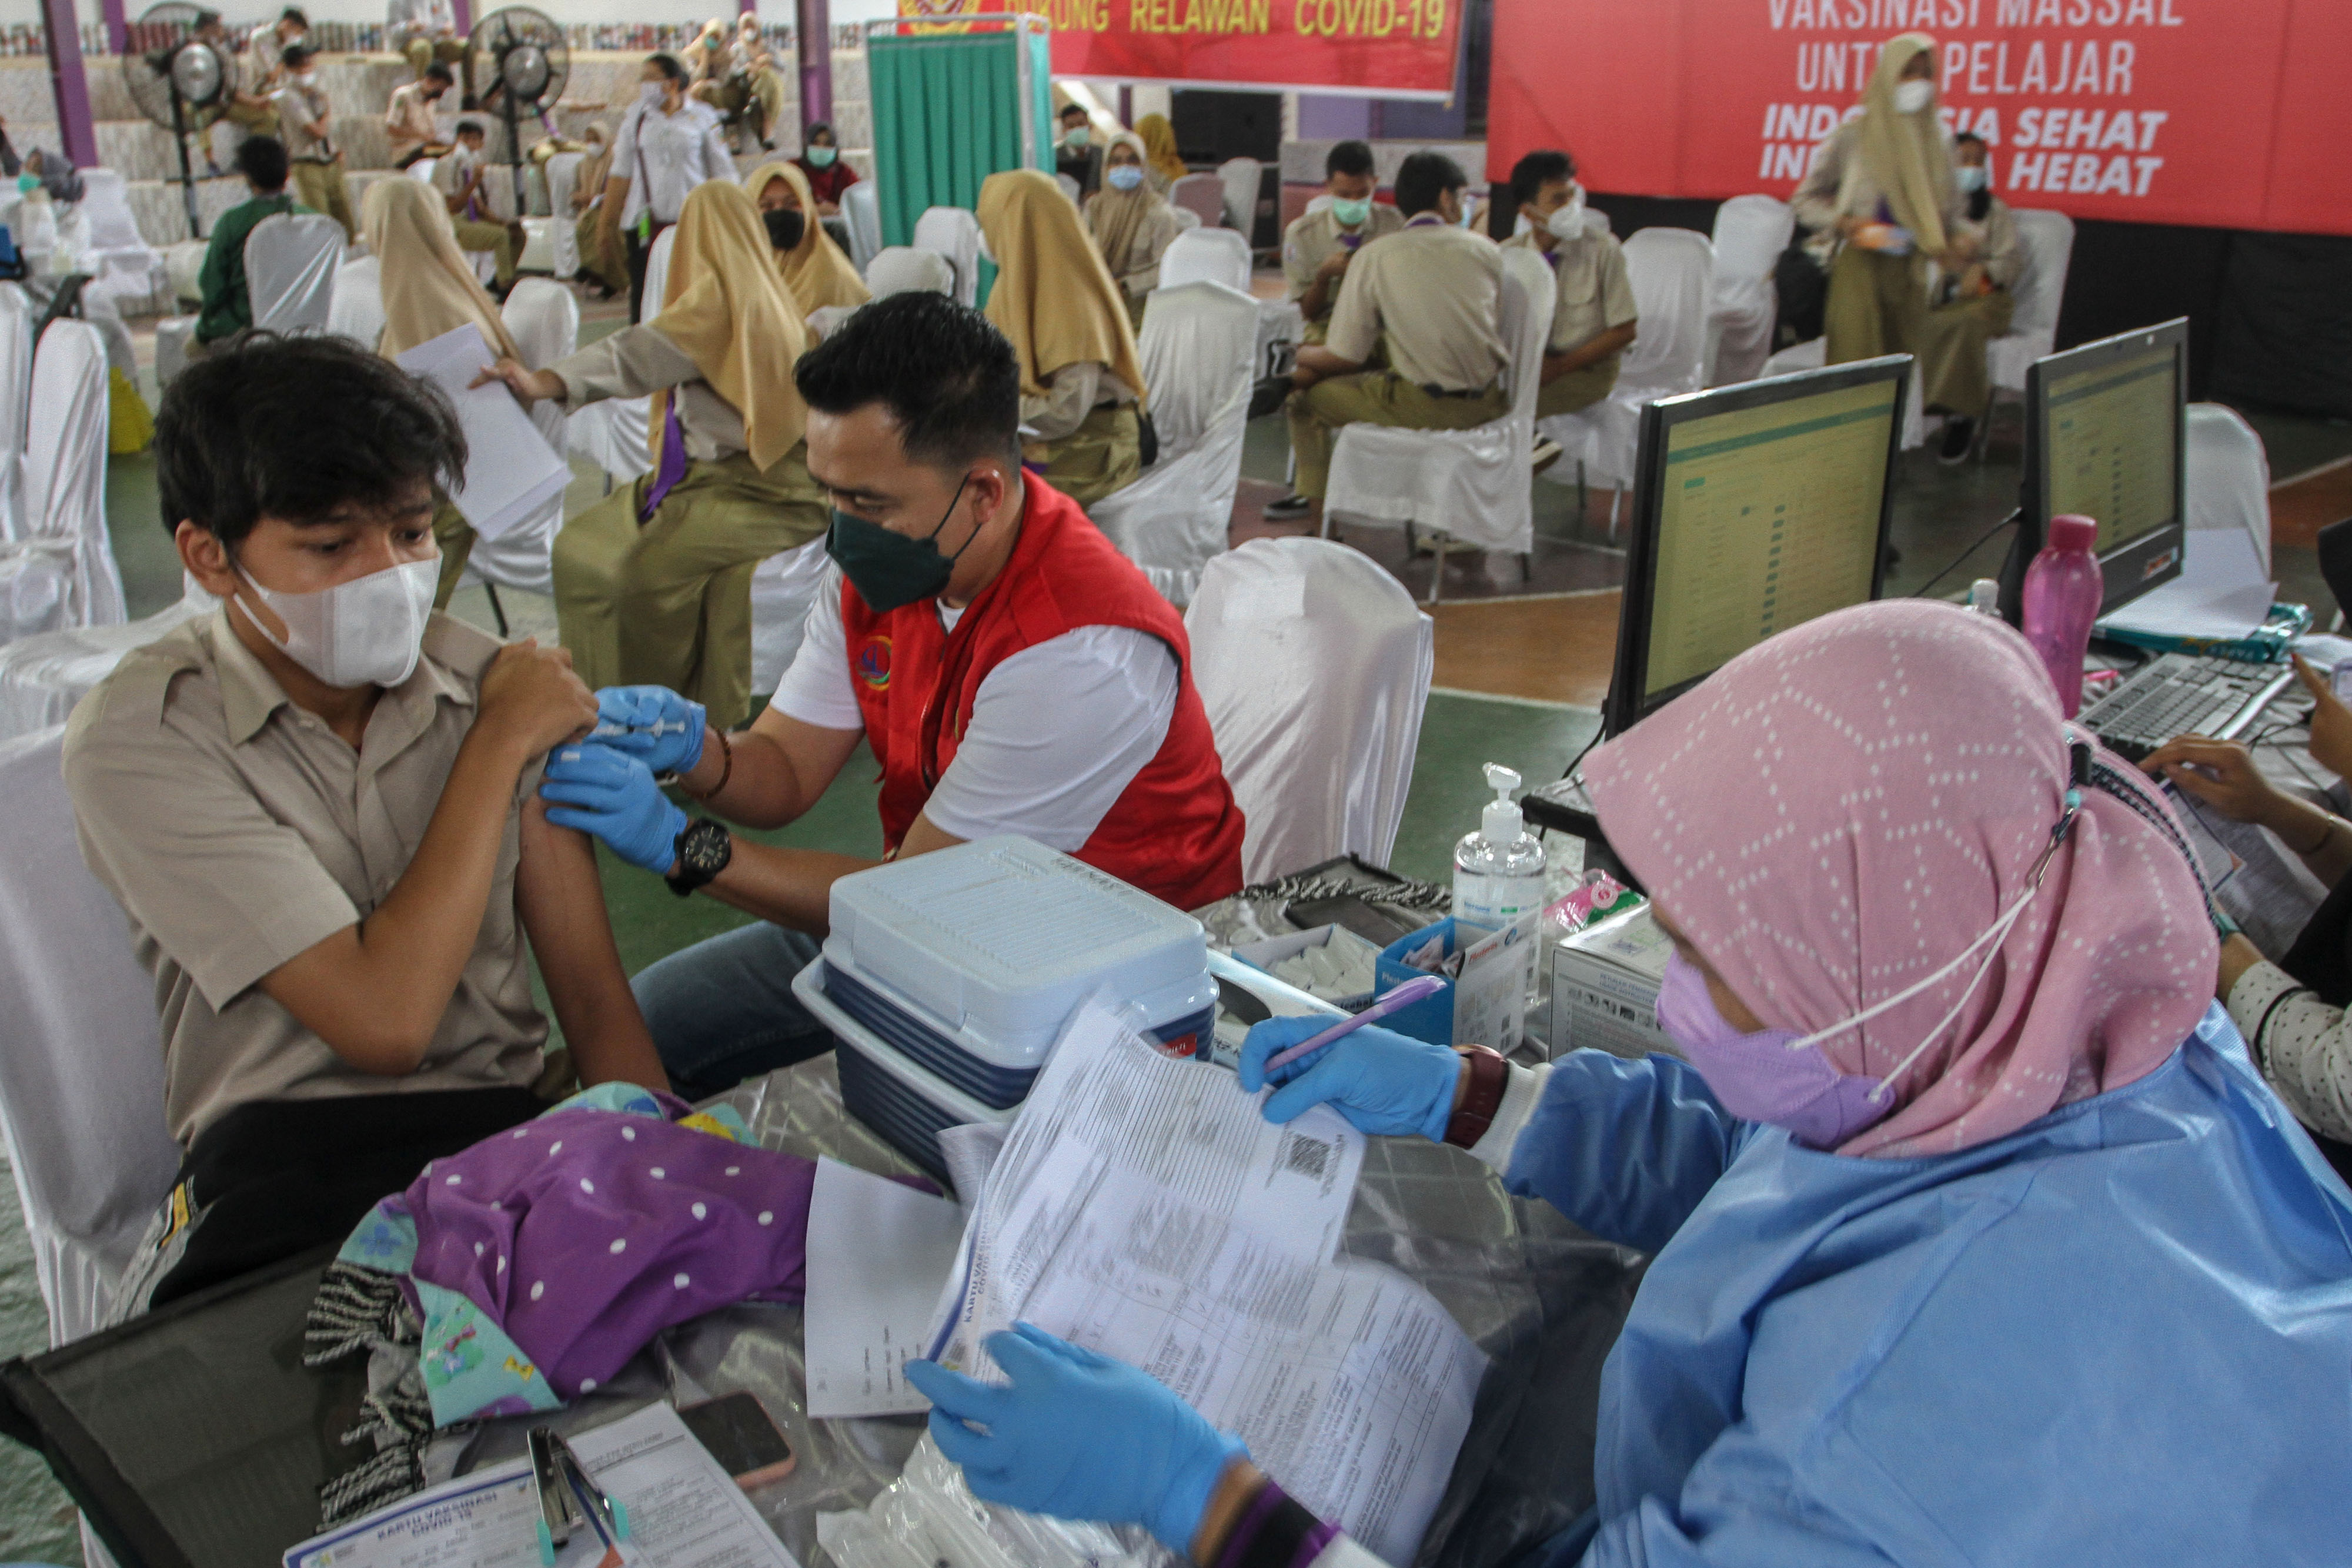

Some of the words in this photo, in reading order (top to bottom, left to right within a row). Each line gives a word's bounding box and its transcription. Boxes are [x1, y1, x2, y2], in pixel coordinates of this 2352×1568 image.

[1130, 0, 1270, 35] RELAWAN
[1294, 0, 1445, 38] COVID-19
[1767, 0, 1979, 30] VAKSINASI
[1996, 0, 2185, 28] MASSAL
[1796, 41, 1885, 92] UNT
[1941, 41, 2137, 96] PELAJAR
[1761, 103, 2001, 148] INDSIA
[2012, 107, 2169, 153] SEHAT
[2006, 152, 2165, 197] HEBAT
